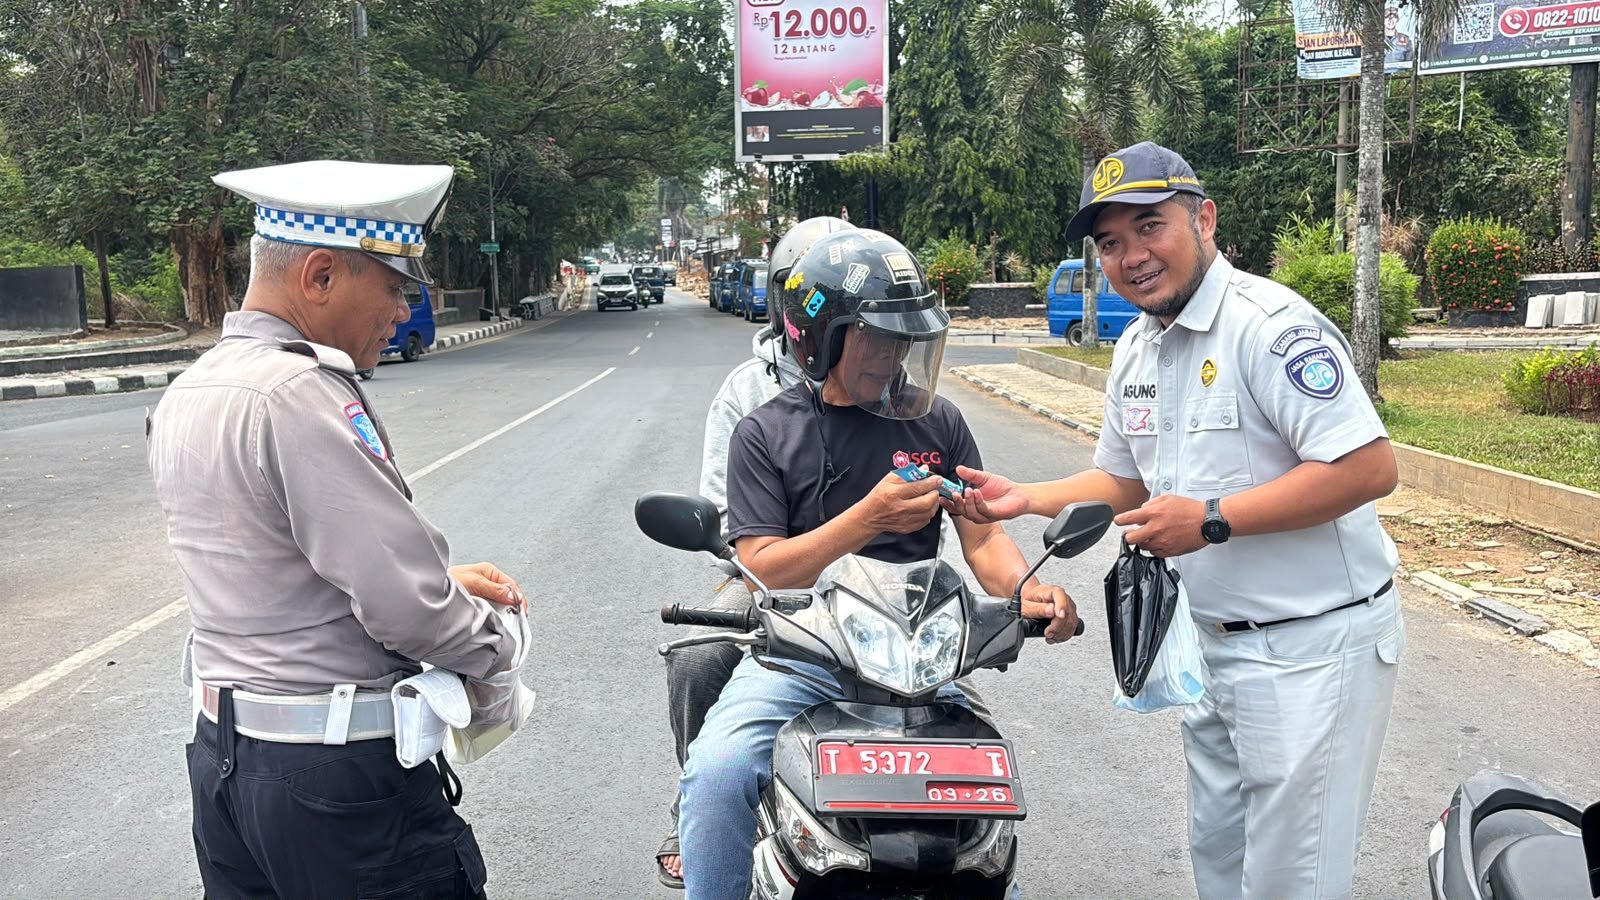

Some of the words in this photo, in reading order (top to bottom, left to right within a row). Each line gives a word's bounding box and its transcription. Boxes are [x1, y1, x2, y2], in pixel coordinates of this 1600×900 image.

[1533, 6, 1600, 28] 0822-1010
[774, 44, 788, 54] 12
[792, 44, 836, 54] BATANG
[1290, 360, 1305, 373] JASA
[1123, 384, 1156, 399] AGUNG
[911, 451, 941, 465] SCG
[880, 583, 926, 593] HONDA
[824, 749, 840, 775] T
[859, 750, 932, 775] 5372
